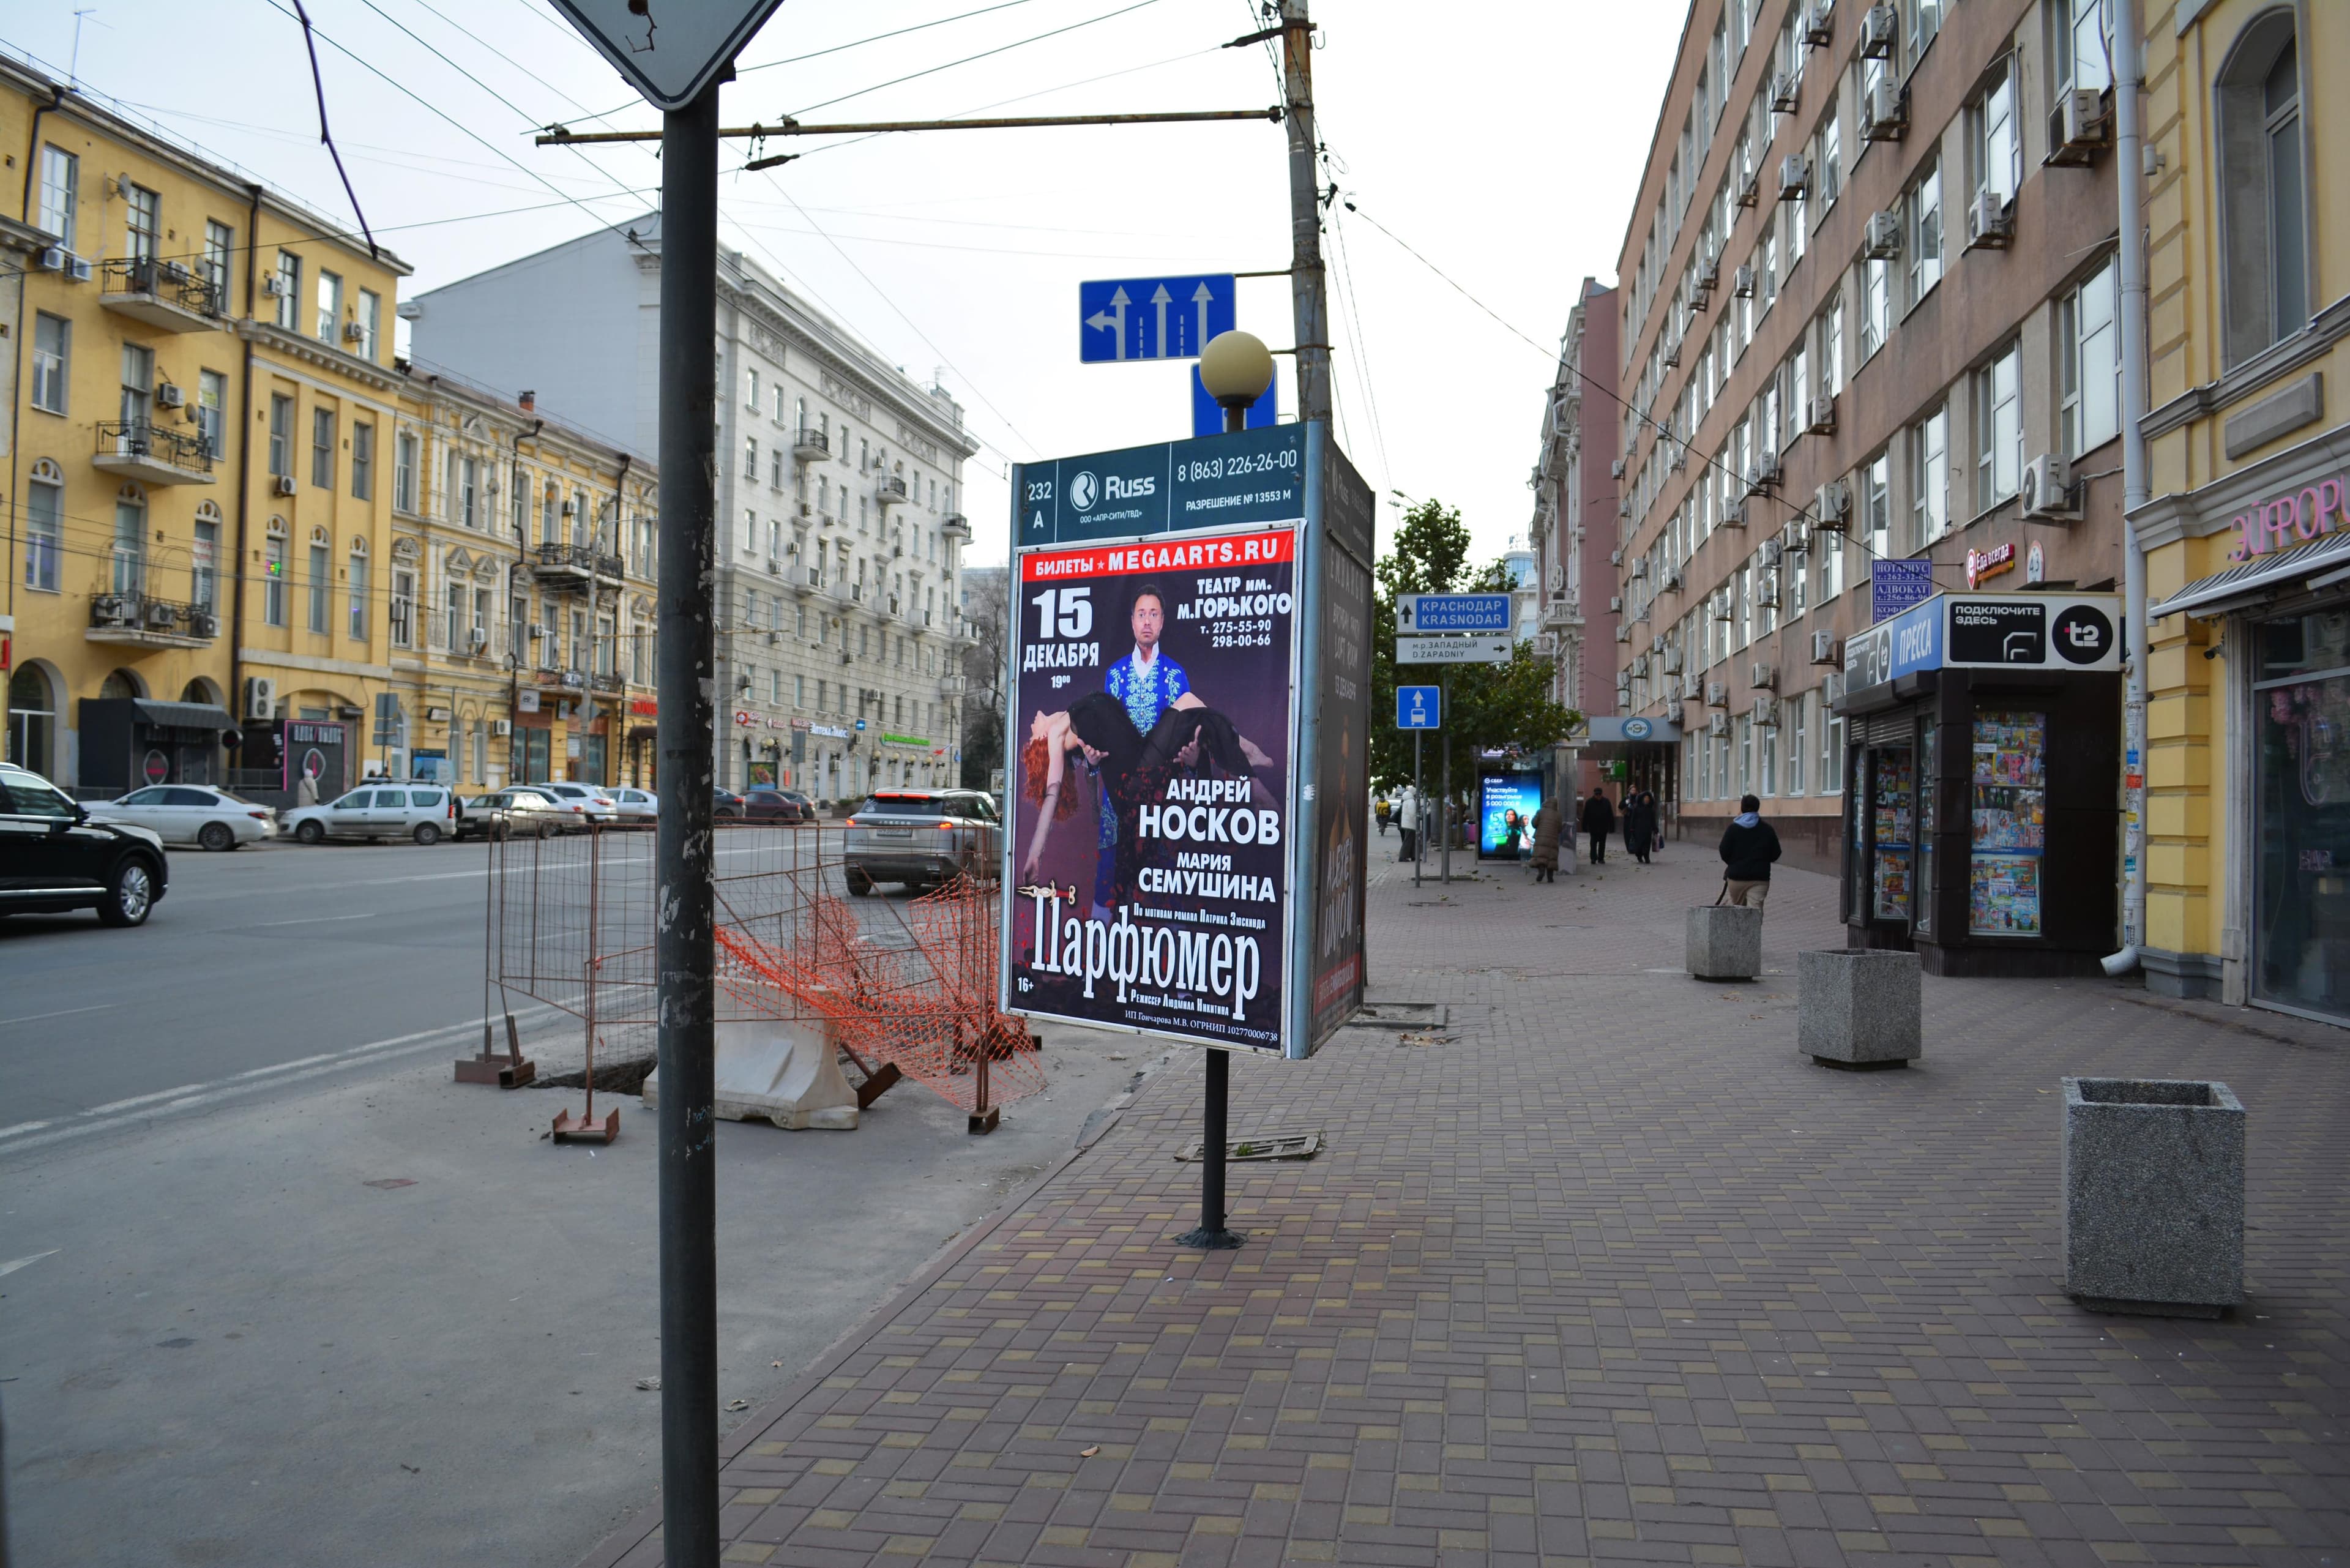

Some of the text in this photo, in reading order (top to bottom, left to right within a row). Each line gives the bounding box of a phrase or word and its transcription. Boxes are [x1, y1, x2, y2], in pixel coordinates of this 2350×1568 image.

[1178, 449, 1297, 482] 8 (863) 226-26-00
[1028, 481, 1052, 501] 232
[1105, 476, 1155, 500] Russ
[1186, 490, 1291, 511] РАЗРЕШЕНИЕ № 13553 М
[1033, 510, 1044, 529] А
[1093, 509, 1143, 522] «АПР-СИТИ/ТВД»
[1035, 538, 1278, 576] БИЛЕТЫ MEGAARTS.RU
[1977, 543, 2009, 572] Еда всегда
[1877, 564, 1928, 573] НОТАРИУС
[1197, 577, 1272, 594] ТЕАТР им.
[1877, 585, 1928, 594] АДВОКАТ
[1032, 586, 1092, 639] 15
[1422, 600, 1502, 612] КРАСНОДАР
[1955, 606, 2041, 616] ПОДКЛЮЧИТЕ
[1200, 619, 1272, 634] т. 275-55-90
[1422, 614, 1502, 625] KRASNODAR
[1955, 616, 1997, 625] ЗДЕСЬ
[1212, 633, 1271, 647] 298-00-66
[1899, 618, 1932, 666] ПРЕССА
[2064, 621, 2099, 647] t2
[1023, 642, 1099, 672] ДЕКАБРЯ
[1166, 775, 1251, 804] АНДРЕЙ
[1139, 804, 1280, 845] НОСКОВ
[1176, 852, 1231, 872] МАРИЯ
[1138, 867, 1277, 903] СЕМУШИНА
[1032, 894, 1259, 1021] Парфюмер
[1018, 977, 1034, 992] 16+
[1125, 1010, 1278, 1041] ИП Гончарова М.В. ОГРНИП 102770006738
